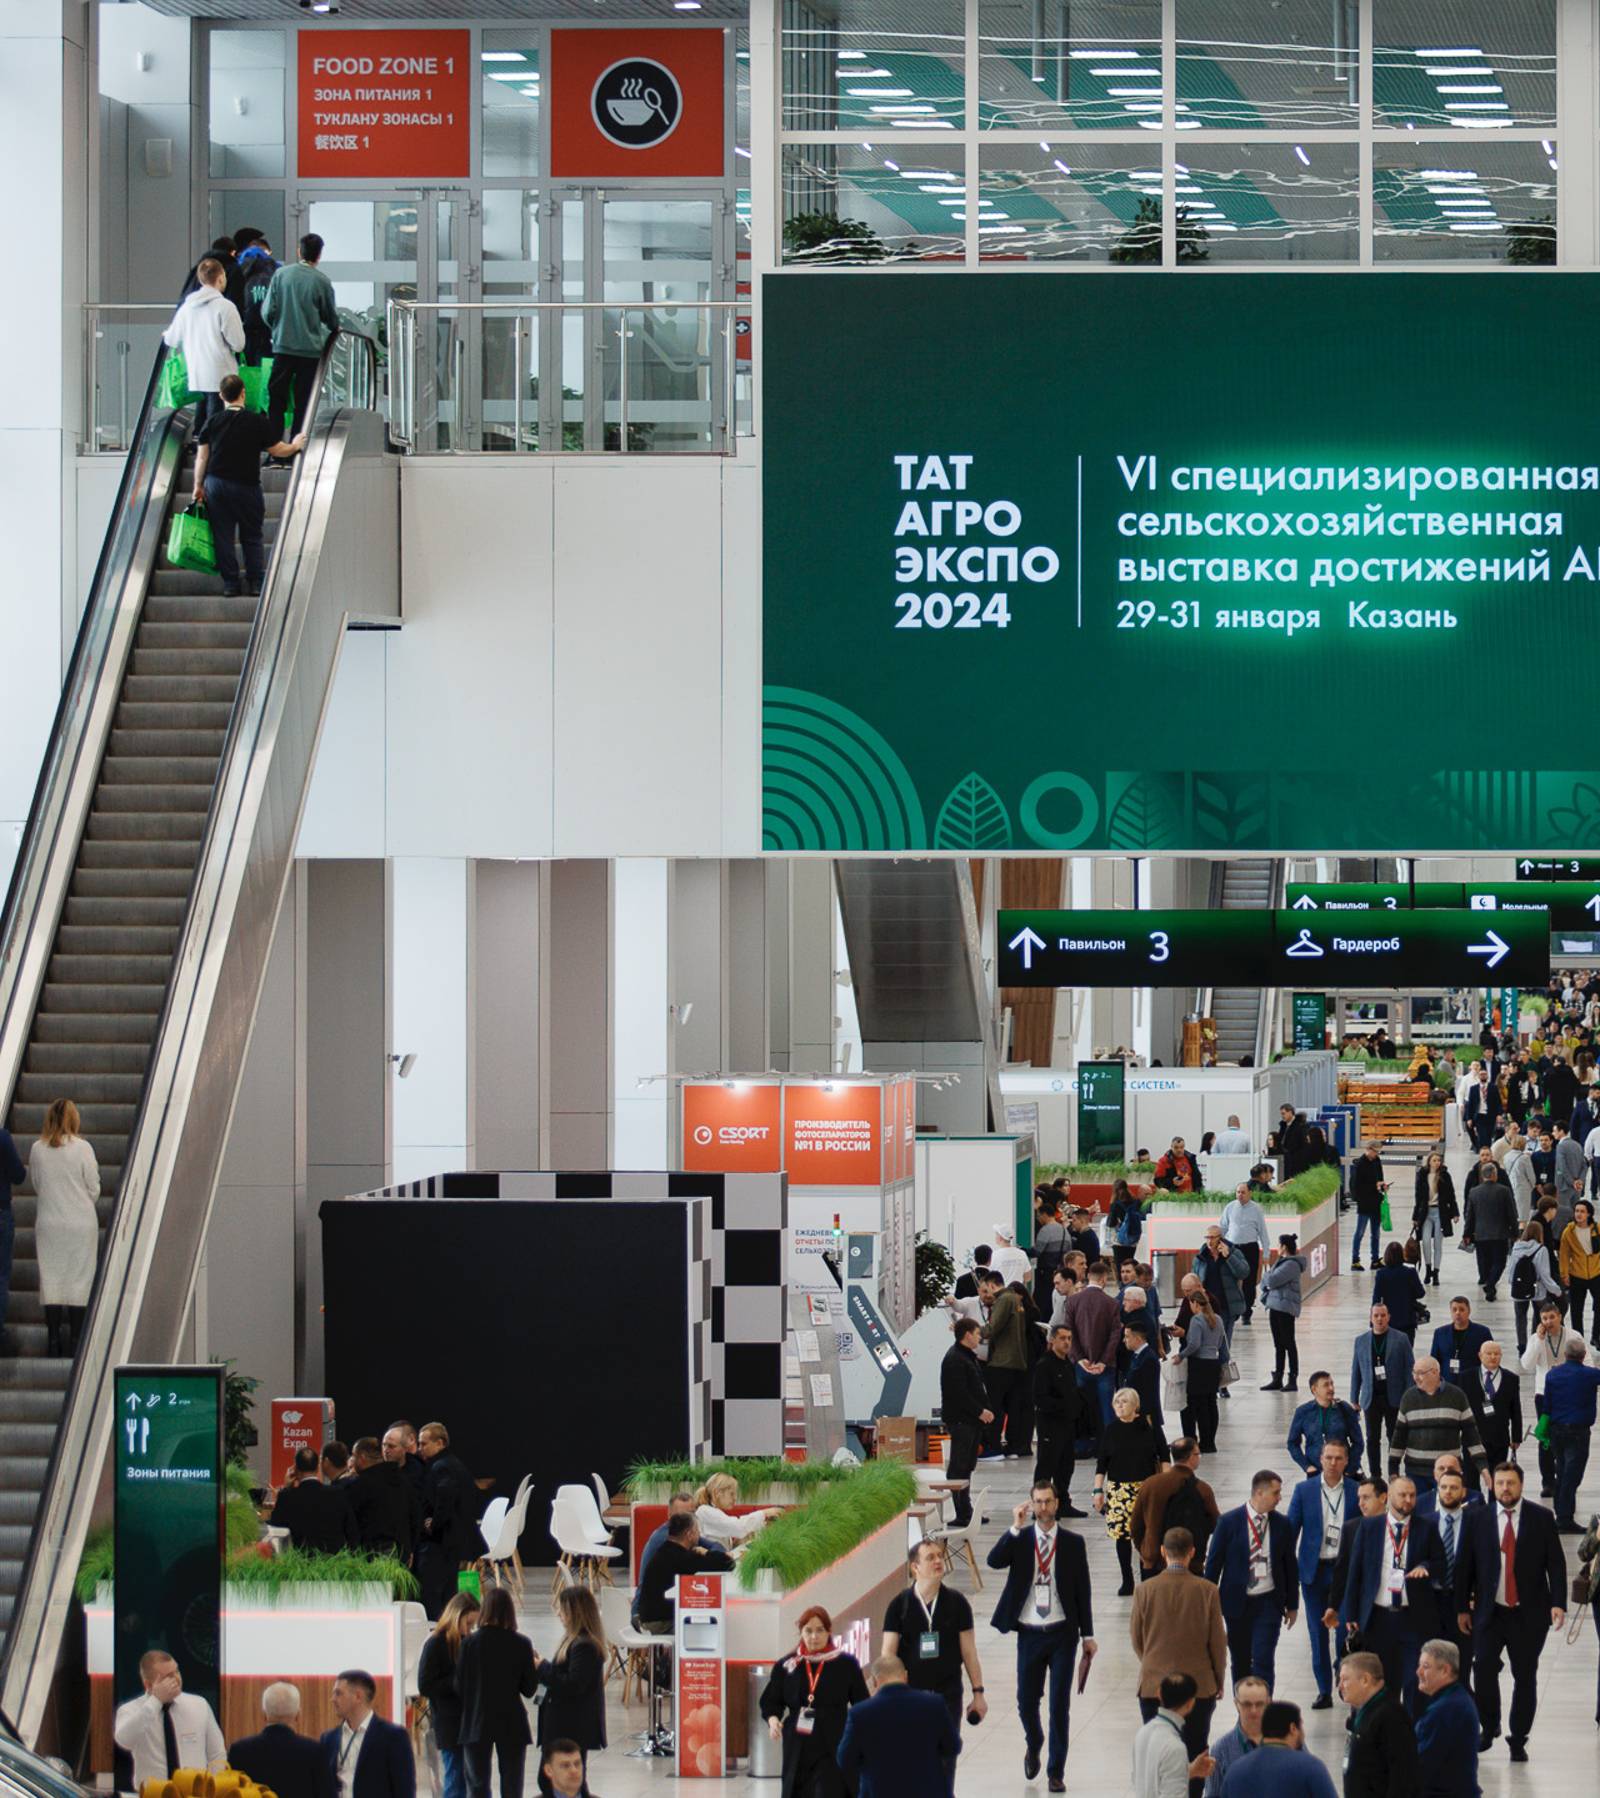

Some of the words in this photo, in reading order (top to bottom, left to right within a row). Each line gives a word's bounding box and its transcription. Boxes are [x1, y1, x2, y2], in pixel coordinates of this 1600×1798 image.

[313, 57, 374, 75] FOOD
[379, 57, 438, 75] ZONE
[445, 57, 454, 75] 1
[314, 89, 352, 101] ЗОНА
[355, 89, 421, 101] ПИТАНИЯ
[425, 89, 432, 101] 1
[382, 113, 443, 126] ЗОНАСЫ
[447, 113, 454, 126] 1
[363, 136, 370, 149] 1
[894, 455, 974, 490] ТАТ
[1116, 455, 1157, 492] VI
[1170, 466, 1600, 502] специализированная
[894, 500, 1022, 537] АГРО
[1117, 503, 1563, 537] сельскохозяйственная
[895, 546, 1060, 583] ЭКСПО
[1118, 558, 1299, 582] выставка
[1310, 548, 1551, 588] достижений
[894, 592, 1012, 629] 2024
[1116, 600, 1201, 629] 29-31
[1215, 609, 1321, 637] января
[1349, 600, 1458, 629] Казань
[1325, 901, 1370, 910] Павильон
[1059, 938, 1126, 950] Павильон
[1149, 931, 1170, 962] 3
[1332, 937, 1400, 953] Гардероб
[794, 1120, 871, 1129] ПРОИЗВОДИТЕЛЬ
[718, 1127, 770, 1139] CSORT
[794, 1130, 871, 1139] ФОТОСЕПАРАТОРОВ
[815, 1140, 823, 1151] В
[825, 1140, 871, 1152] РОССИИ
[168, 1392, 177, 1405] 2
[283, 1427, 313, 1437] Kazan
[283, 1439, 308, 1450] Expo
[126, 1467, 159, 1479] Зоны
[161, 1468, 211, 1479] питания
